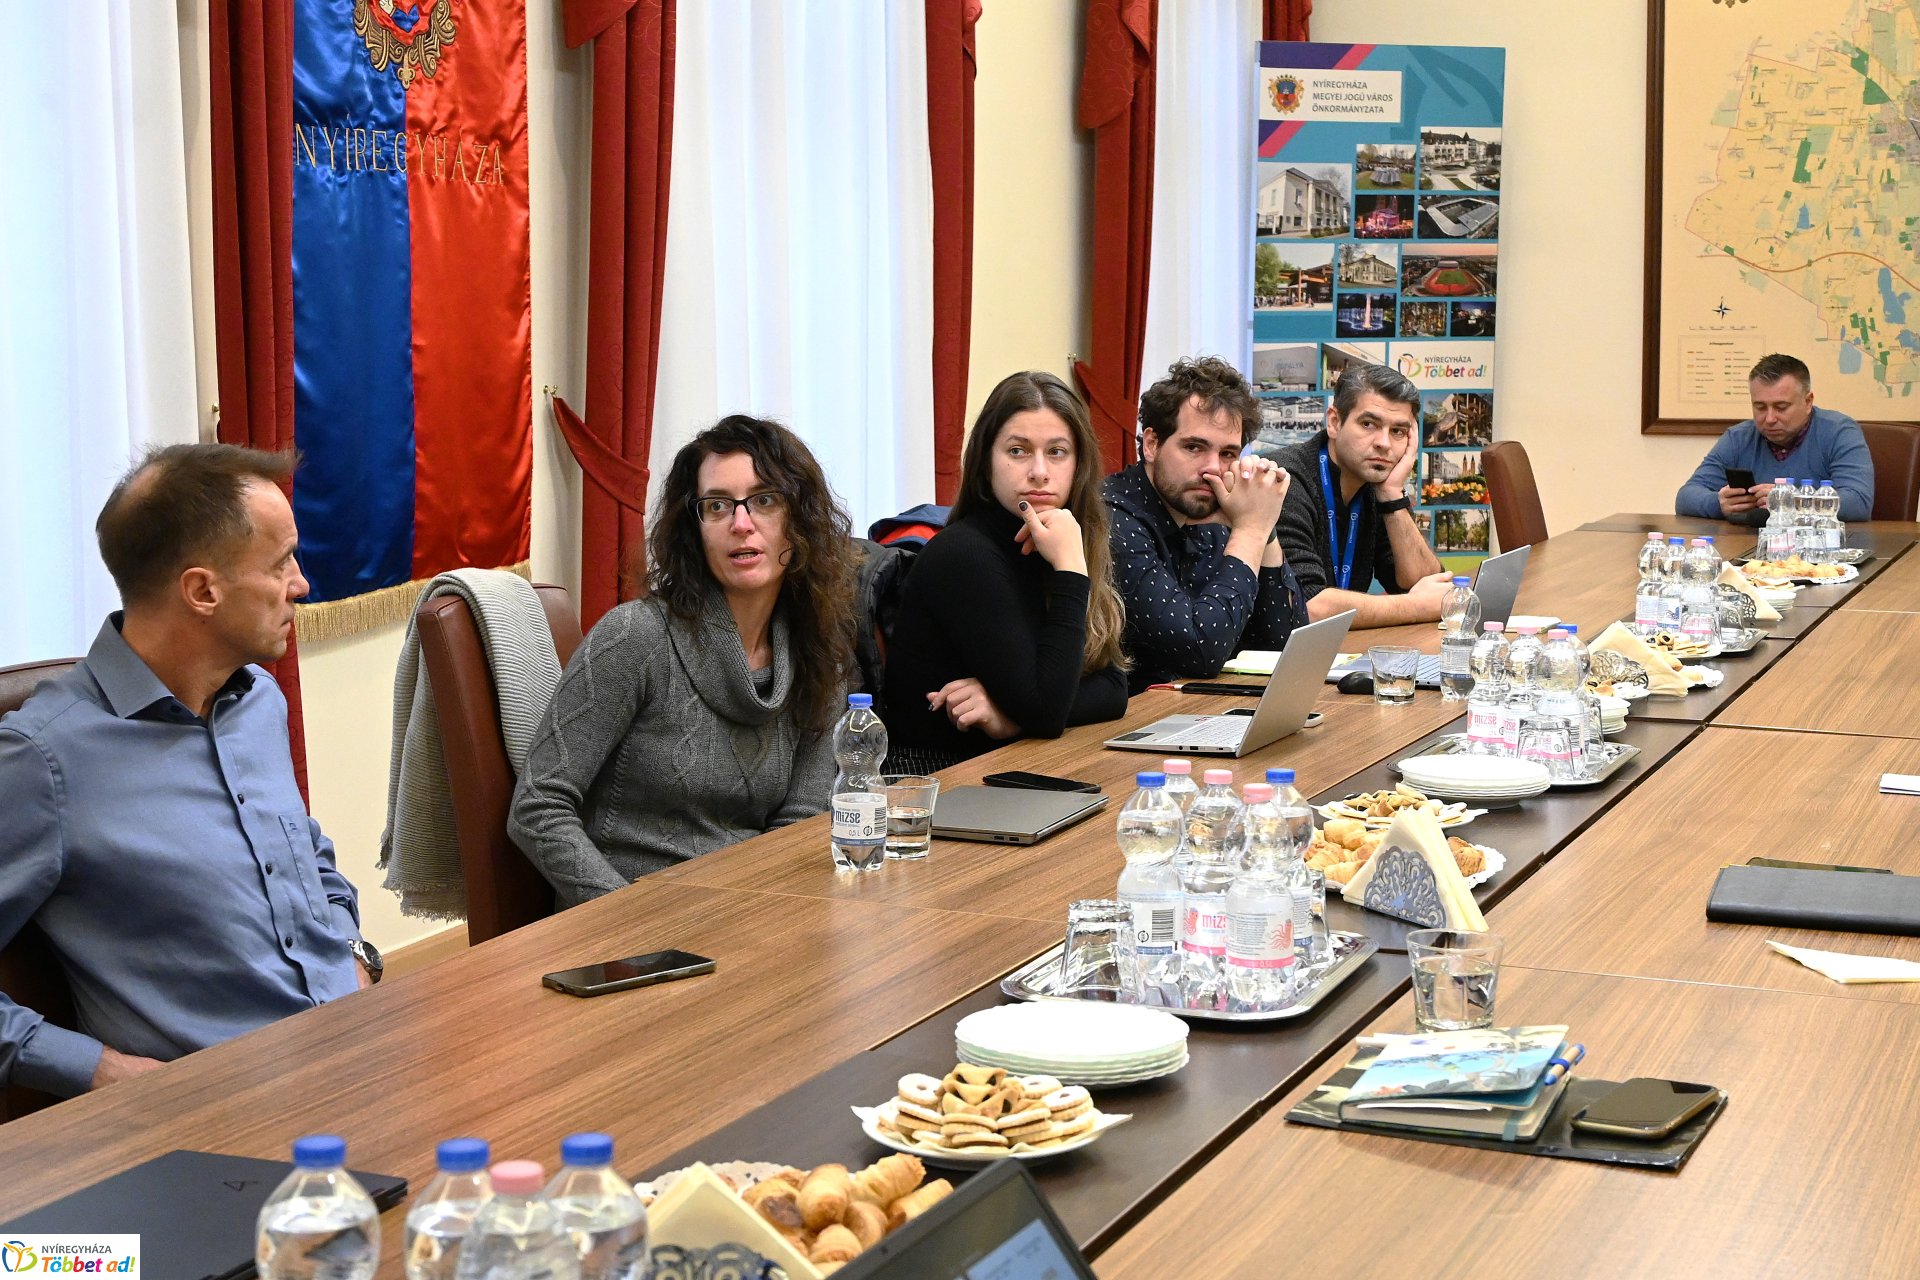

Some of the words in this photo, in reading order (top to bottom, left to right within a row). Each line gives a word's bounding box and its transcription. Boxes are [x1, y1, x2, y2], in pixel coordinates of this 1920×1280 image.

[1313, 79, 1368, 89] NYÍREGYHÁZA
[1313, 92, 1342, 101] MEGYEI
[1344, 92, 1365, 101] JOGÚ
[1366, 93, 1393, 102] VÁROS
[1312, 103, 1384, 113] ÖNKORMÁNYZATA
[1424, 355, 1472, 363] NYÍREGYHÁZA
[1424, 364, 1465, 378] Többet
[1467, 364, 1488, 378] ad!
[836, 811, 860, 823] mizse
[1202, 914, 1226, 928] miz
